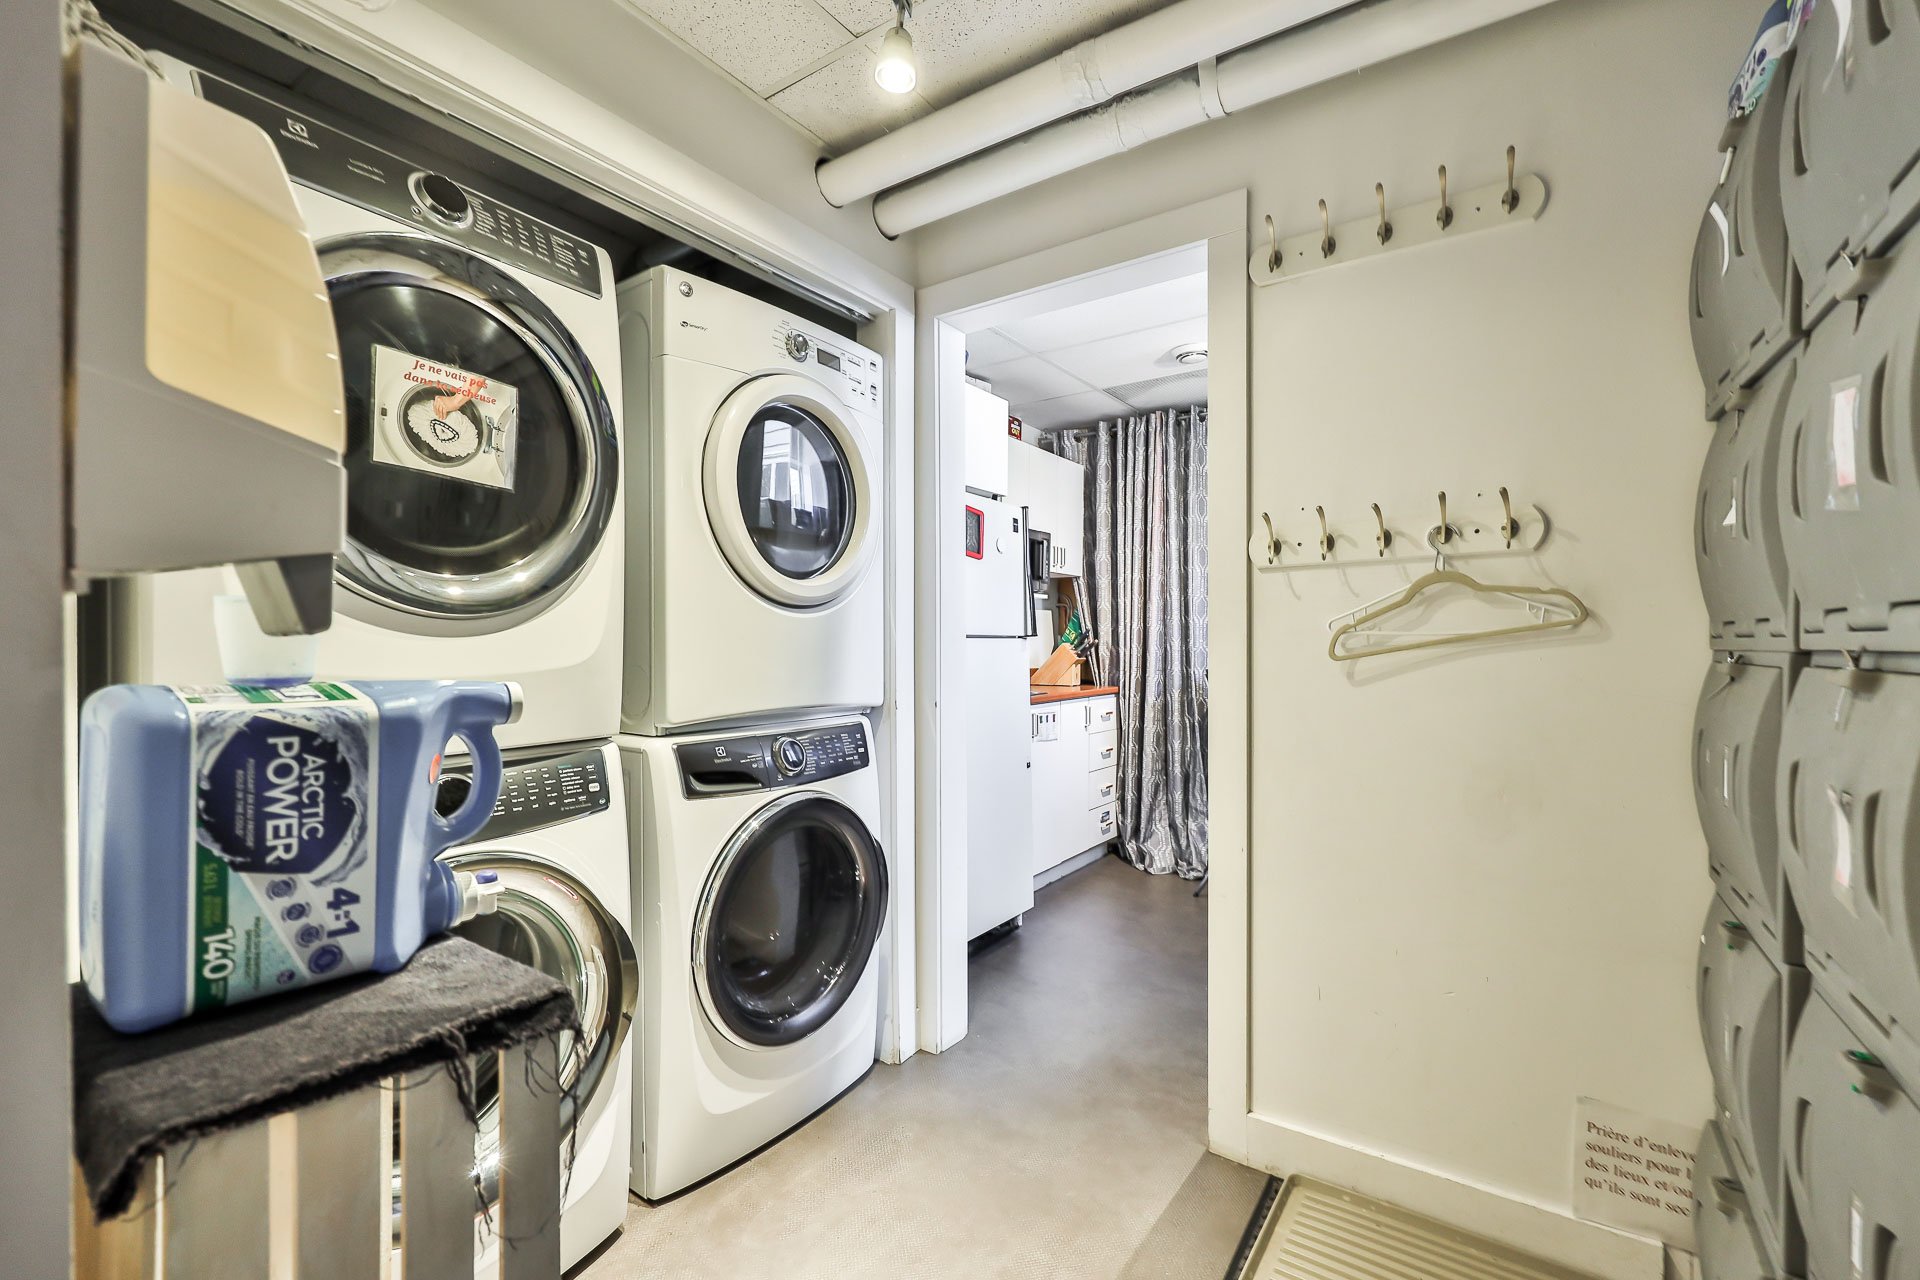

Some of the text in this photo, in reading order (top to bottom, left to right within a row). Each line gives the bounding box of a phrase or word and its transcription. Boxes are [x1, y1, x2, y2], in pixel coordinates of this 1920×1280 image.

[412, 360, 426, 370] Je
[428, 365, 442, 375] ne
[445, 370, 468, 383] vais
[404, 372, 433, 387] dans
[450, 385, 497, 405] sécheuse
[262, 736, 300, 864] POWER
[301, 753, 327, 840] ARCTIC
[202, 926, 235, 980] 140
[1586, 1121, 1630, 1143] Prière
[1584, 1157, 1609, 1173] des
[1613, 1164, 1650, 1186] lieux
[1585, 1142, 1642, 1164] souliers
[1646, 1159, 1682, 1177] pour
[1584, 1176, 1626, 1197] qu'ils
[1629, 1190, 1661, 1208] sont
